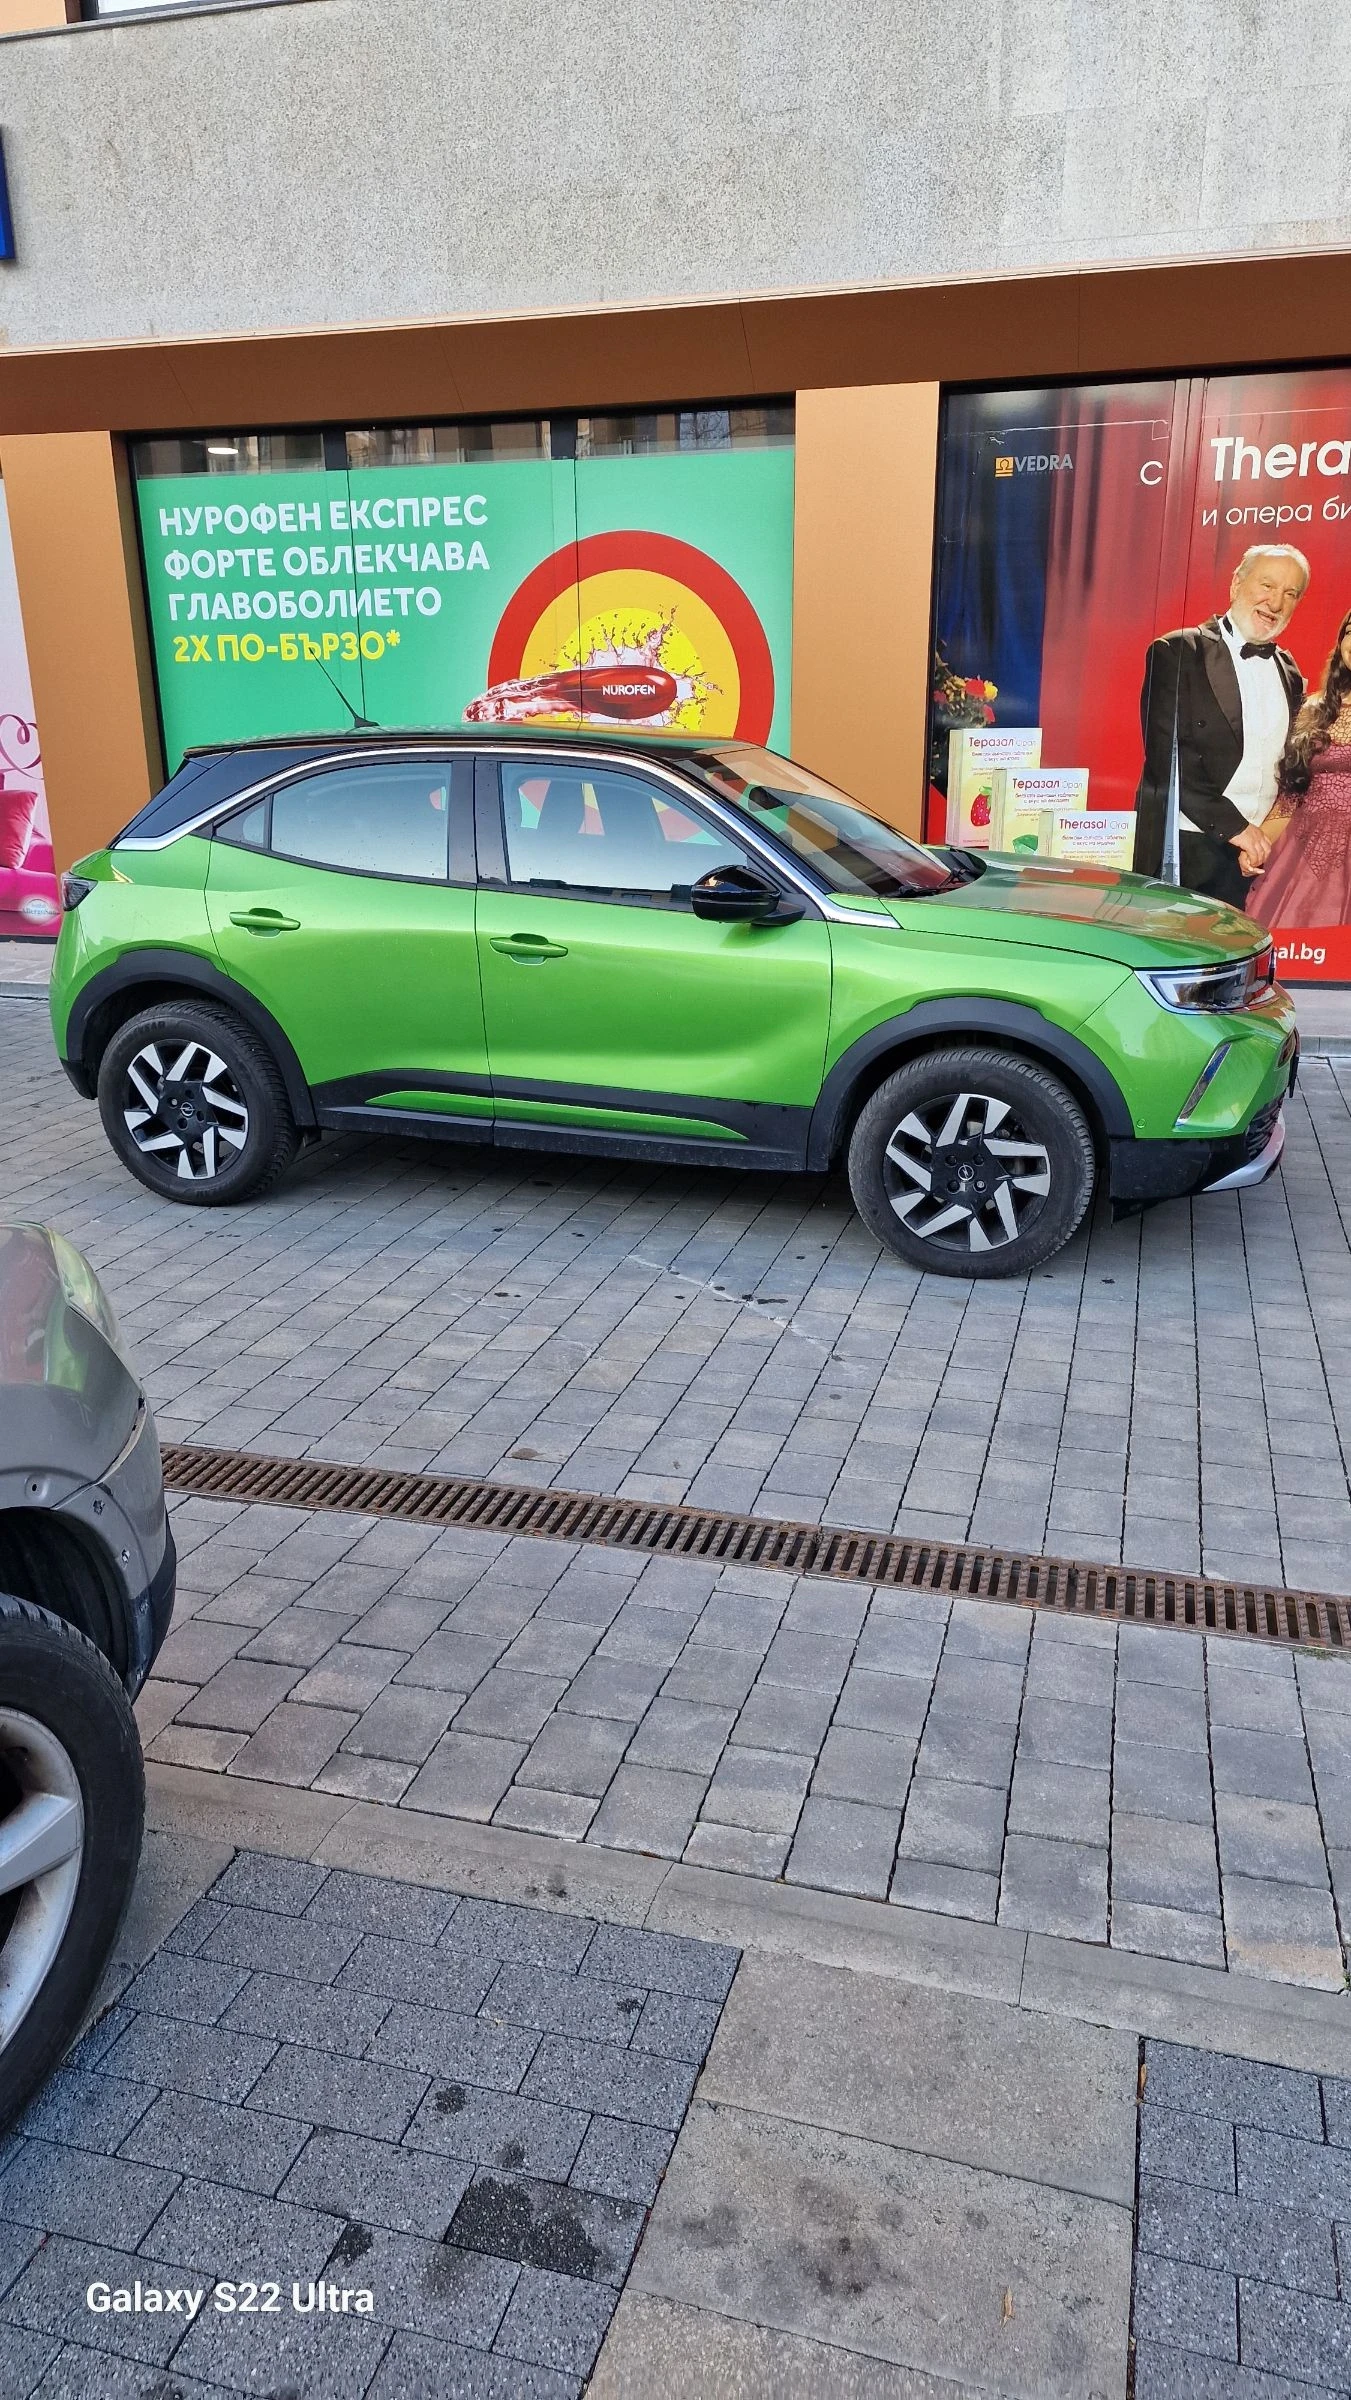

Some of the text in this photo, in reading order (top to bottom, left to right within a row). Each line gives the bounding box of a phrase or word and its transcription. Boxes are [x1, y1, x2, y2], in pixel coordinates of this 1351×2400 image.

[1014, 453, 1074, 472] VEDRA
[1210, 436, 1351, 482] Thera
[159, 494, 489, 536] НУРОФЕН ЕКСПРЕС
[1202, 508, 1218, 527] и
[1225, 503, 1313, 528] опера
[164, 540, 490, 580] ФОРТЕ ОБЛЕКЧАВА
[168, 586, 443, 621] ГЛАВОБОЛИЕТО
[601, 684, 656, 696] NUROFEN
[968, 736, 1014, 749] Теразал
[1012, 778, 1060, 791] Теразал
[1059, 818, 1107, 830] Therasal
